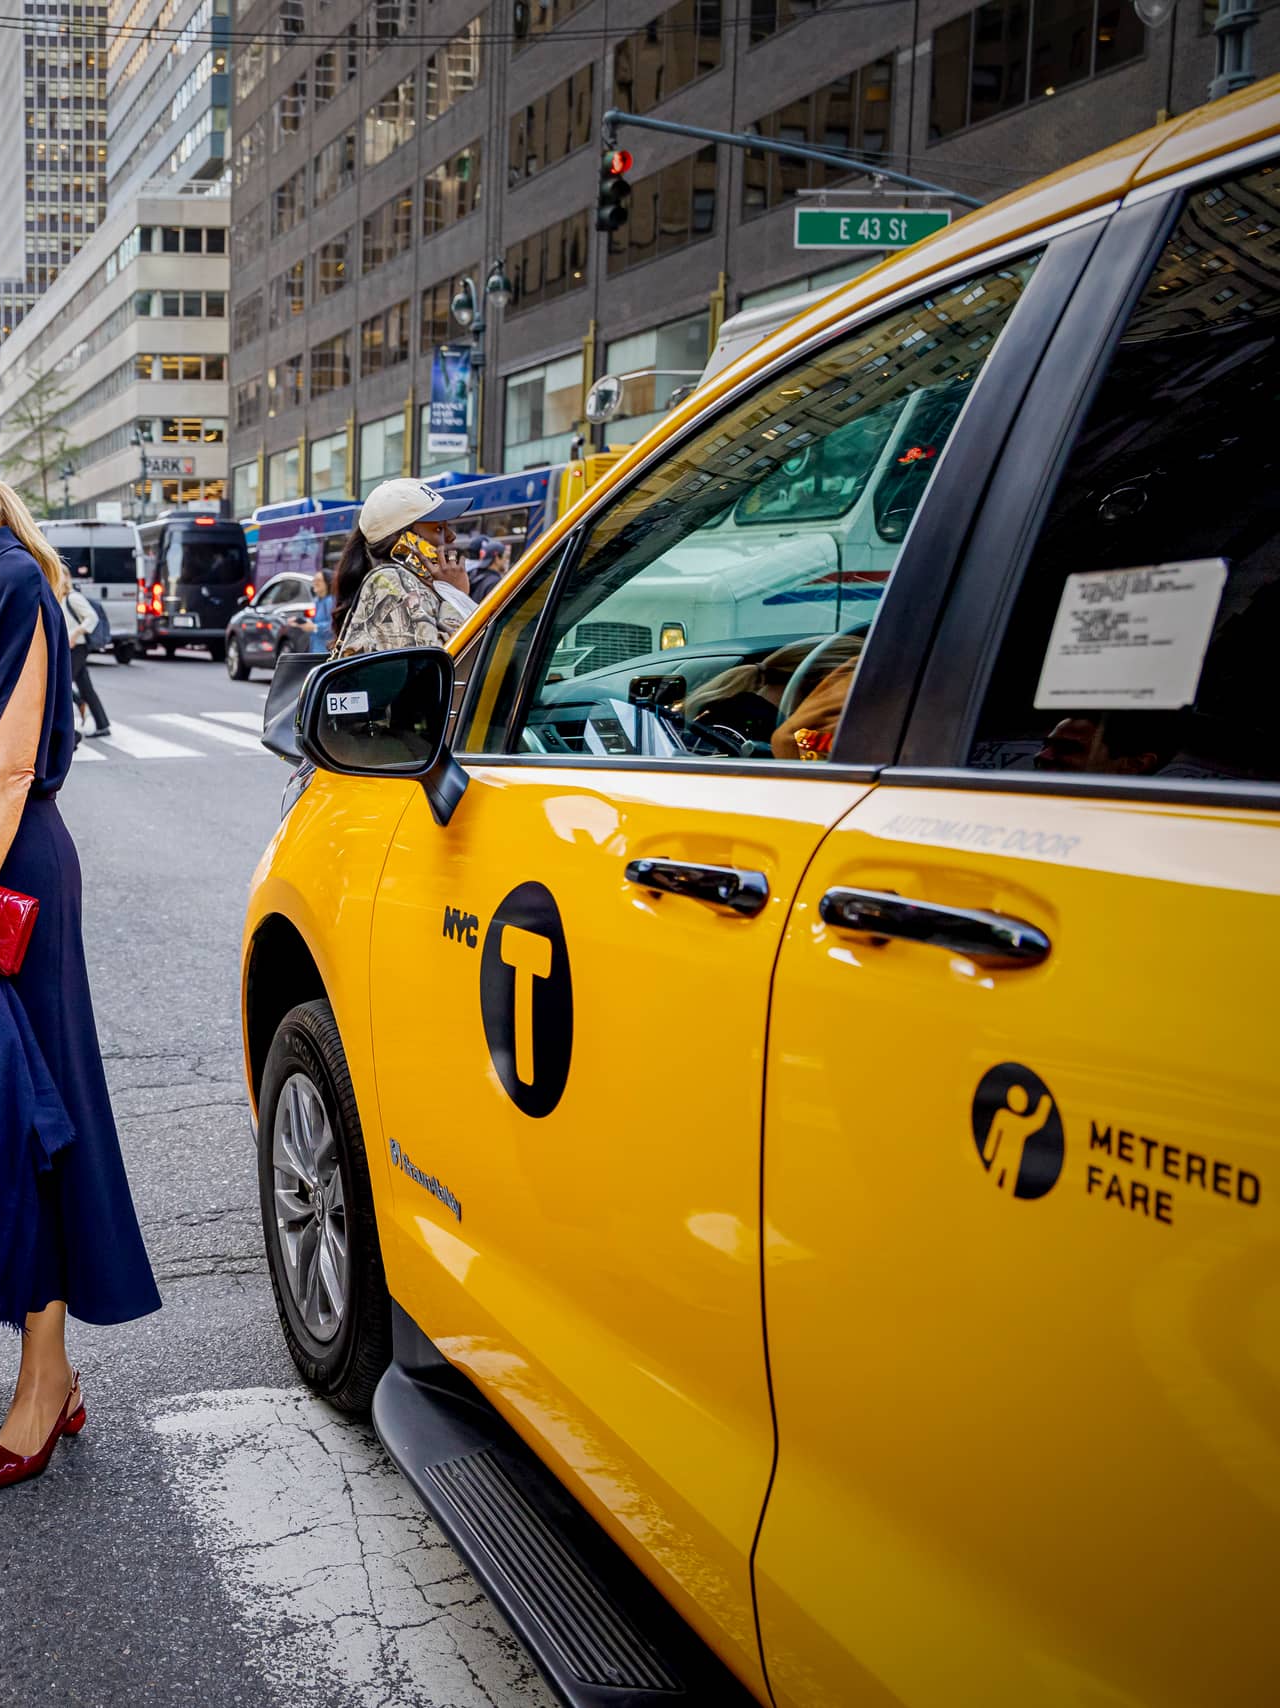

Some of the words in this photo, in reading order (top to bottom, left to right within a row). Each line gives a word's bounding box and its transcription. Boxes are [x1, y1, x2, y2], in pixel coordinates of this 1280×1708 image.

[839, 217, 851, 240] E
[857, 218, 881, 241] 43
[888, 218, 908, 241] St
[144, 457, 181, 473] PARK
[330, 696, 348, 711] BK
[879, 814, 1006, 847] AUTOMATIC
[1001, 828, 1082, 858] DOOR
[442, 905, 479, 949] NYC
[1090, 1119, 1261, 1208] METERED
[1087, 1164, 1174, 1227] FARE
